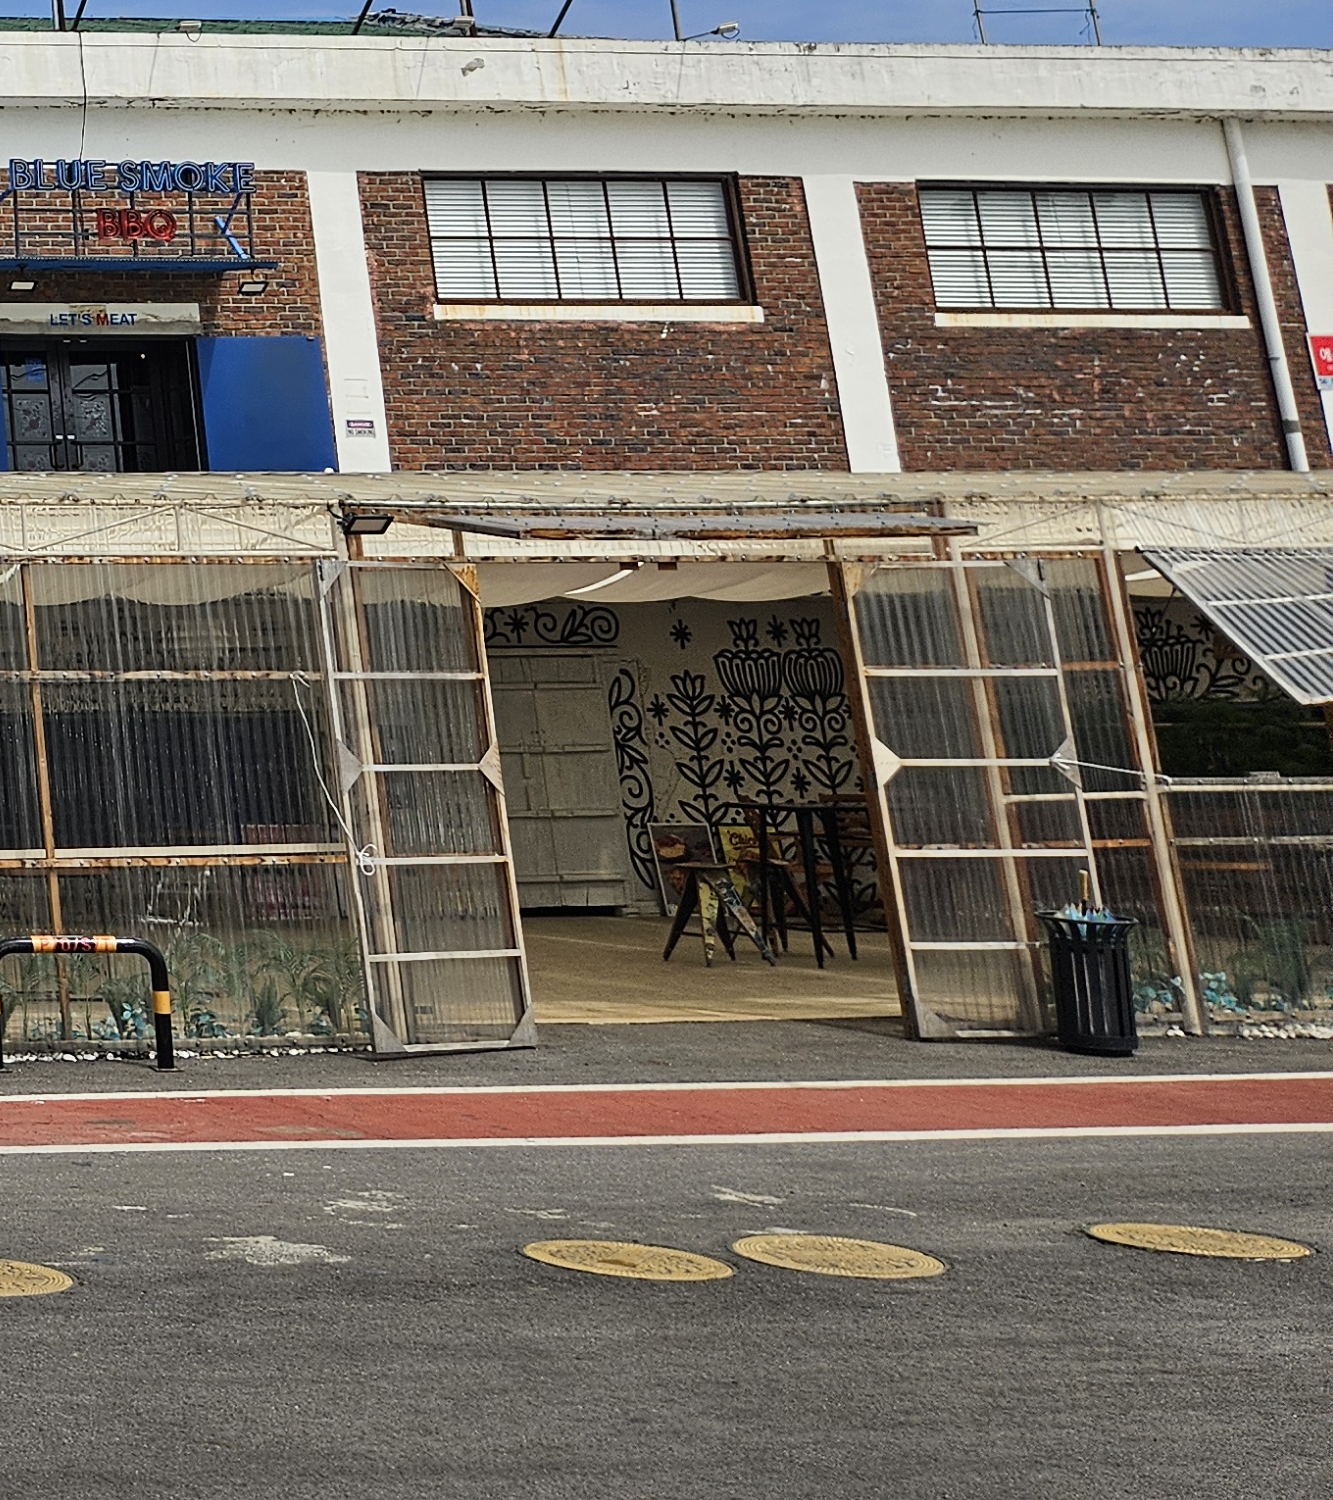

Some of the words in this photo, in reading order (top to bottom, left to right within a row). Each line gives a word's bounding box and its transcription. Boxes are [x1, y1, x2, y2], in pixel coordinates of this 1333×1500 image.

[9, 158, 109, 191] BLUE
[118, 159, 256, 193] SMOKE
[96, 207, 177, 242] BBQ
[49, 313, 92, 327] LET'S
[96, 313, 138, 326] MEAT
